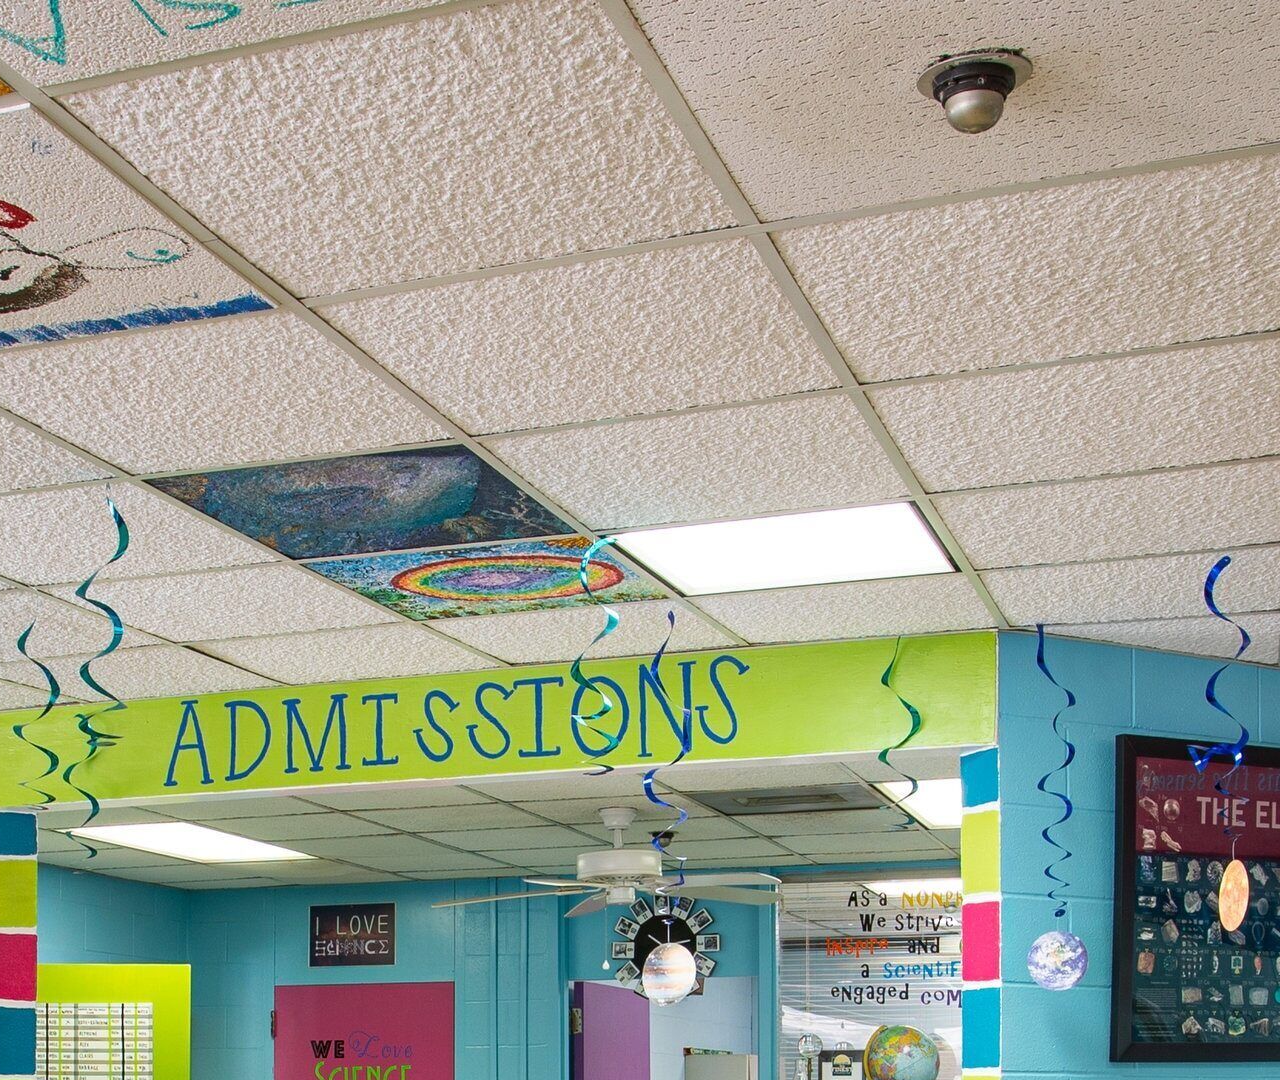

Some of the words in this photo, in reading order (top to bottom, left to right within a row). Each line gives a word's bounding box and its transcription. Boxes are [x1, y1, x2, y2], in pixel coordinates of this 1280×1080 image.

[164, 654, 750, 787] ADMISSIONS
[1196, 796, 1247, 828] THE
[336, 914, 389, 936] LOVE
[859, 912, 887, 932] We
[311, 1039, 346, 1060] WE
